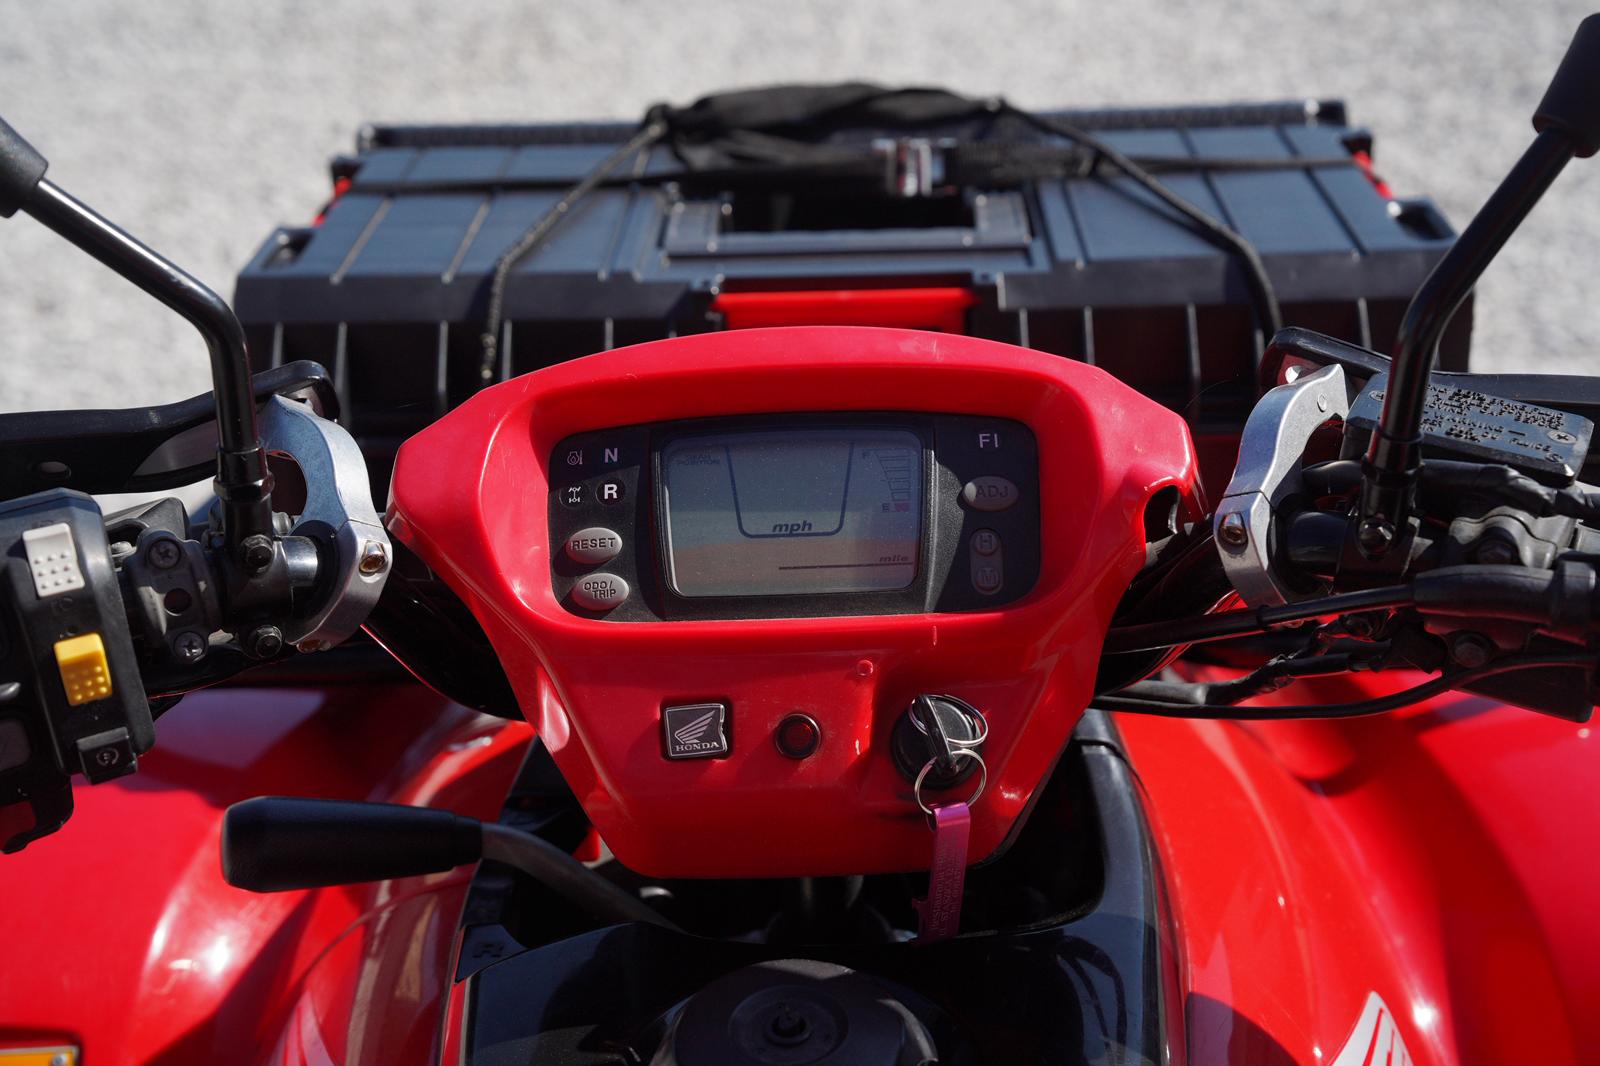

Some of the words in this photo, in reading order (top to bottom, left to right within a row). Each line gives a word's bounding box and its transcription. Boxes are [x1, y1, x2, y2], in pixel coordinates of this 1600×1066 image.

[978, 433, 999, 448] FI
[604, 448, 618, 464] N
[604, 484, 618, 500] R
[976, 484, 1009, 498] ADJ
[881, 502, 890, 512] E
[772, 521, 813, 533] mph
[570, 537, 616, 550] RESET
[592, 588, 617, 599] TRIP
[674, 741, 720, 752] HONDA
